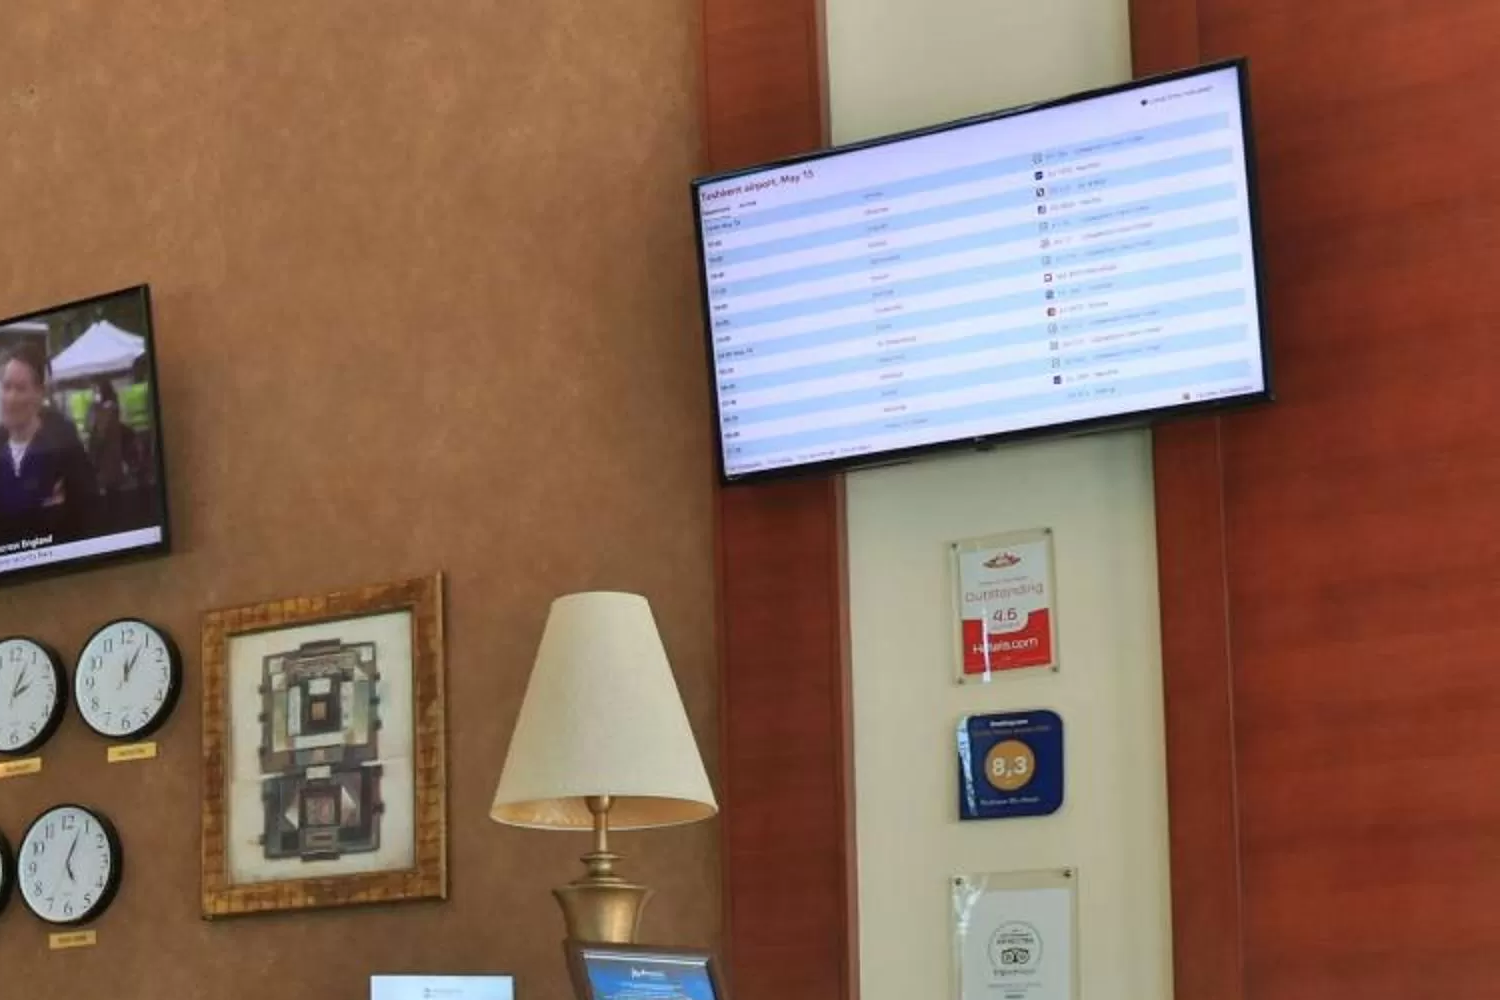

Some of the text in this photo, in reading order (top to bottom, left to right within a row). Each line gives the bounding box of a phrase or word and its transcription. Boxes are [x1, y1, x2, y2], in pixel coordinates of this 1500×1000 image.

[701, 186, 742, 201] Tashkent
[780, 174, 800, 185] May
[803, 169, 814, 178] 15
[22, 534, 53, 551] England
[965, 583, 1044, 602] Outstanding
[993, 607, 1017, 622] 4.6
[121, 628, 135, 645] 12
[145, 632, 149, 648] 1
[103, 638, 113, 653] 11
[10, 647, 23, 662] 12
[31, 651, 37, 665] 1
[155, 647, 164, 662] 2
[90, 656, 103, 672] 10
[161, 666, 168, 681] 3
[85, 676, 95, 690] 9
[153, 689, 162, 701] 4
[91, 696, 99, 711] 8
[104, 711, 112, 726] 7
[121, 713, 131, 729] 6
[140, 707, 149, 722] 5
[29, 722, 37, 735] 5
[9, 729, 19, 744] 6
[61, 815, 75, 831] 12
[85, 819, 89, 833] 1
[45, 823, 55, 839] 11
[32, 841, 45, 856] 10
[96, 833, 104, 849] 2
[100, 853, 108, 868] 3
[29, 862, 37, 876] 9
[34, 881, 43, 896] 8
[95, 876, 104, 888] 4
[45, 898, 54, 912] 7
[63, 901, 72, 916] 6
[83, 894, 91, 909] 5
